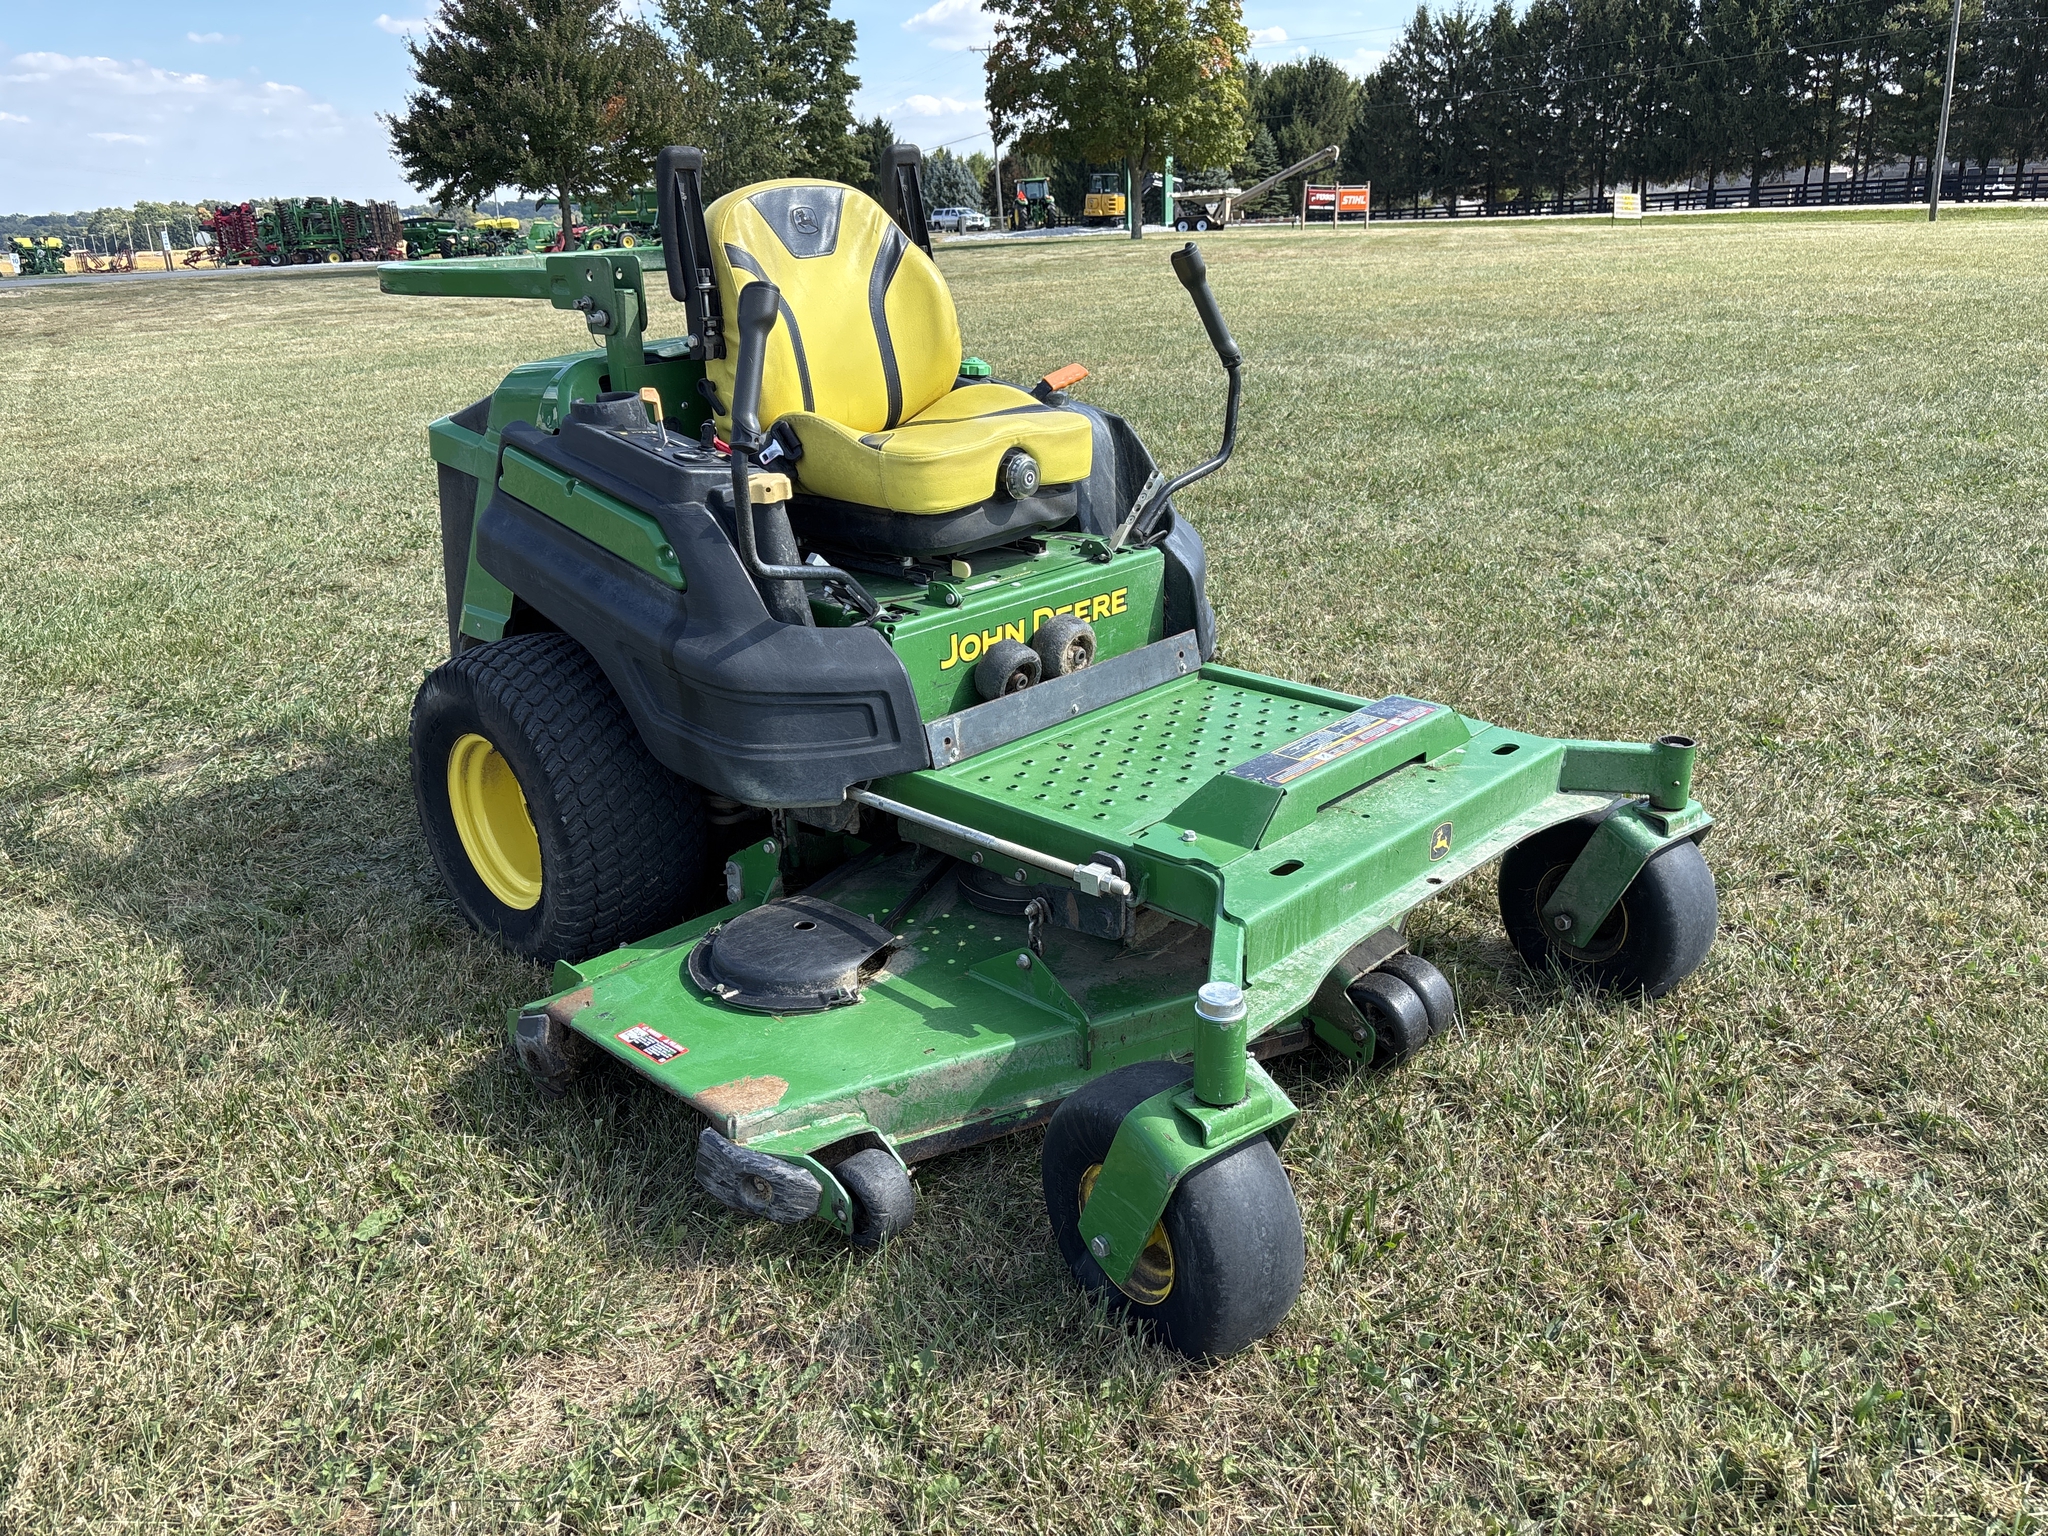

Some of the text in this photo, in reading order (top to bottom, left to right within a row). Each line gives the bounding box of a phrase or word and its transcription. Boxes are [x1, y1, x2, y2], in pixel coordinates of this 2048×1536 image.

[1342, 195, 1366, 204] STIHL
[940, 587, 1128, 671] JOHN DERE
